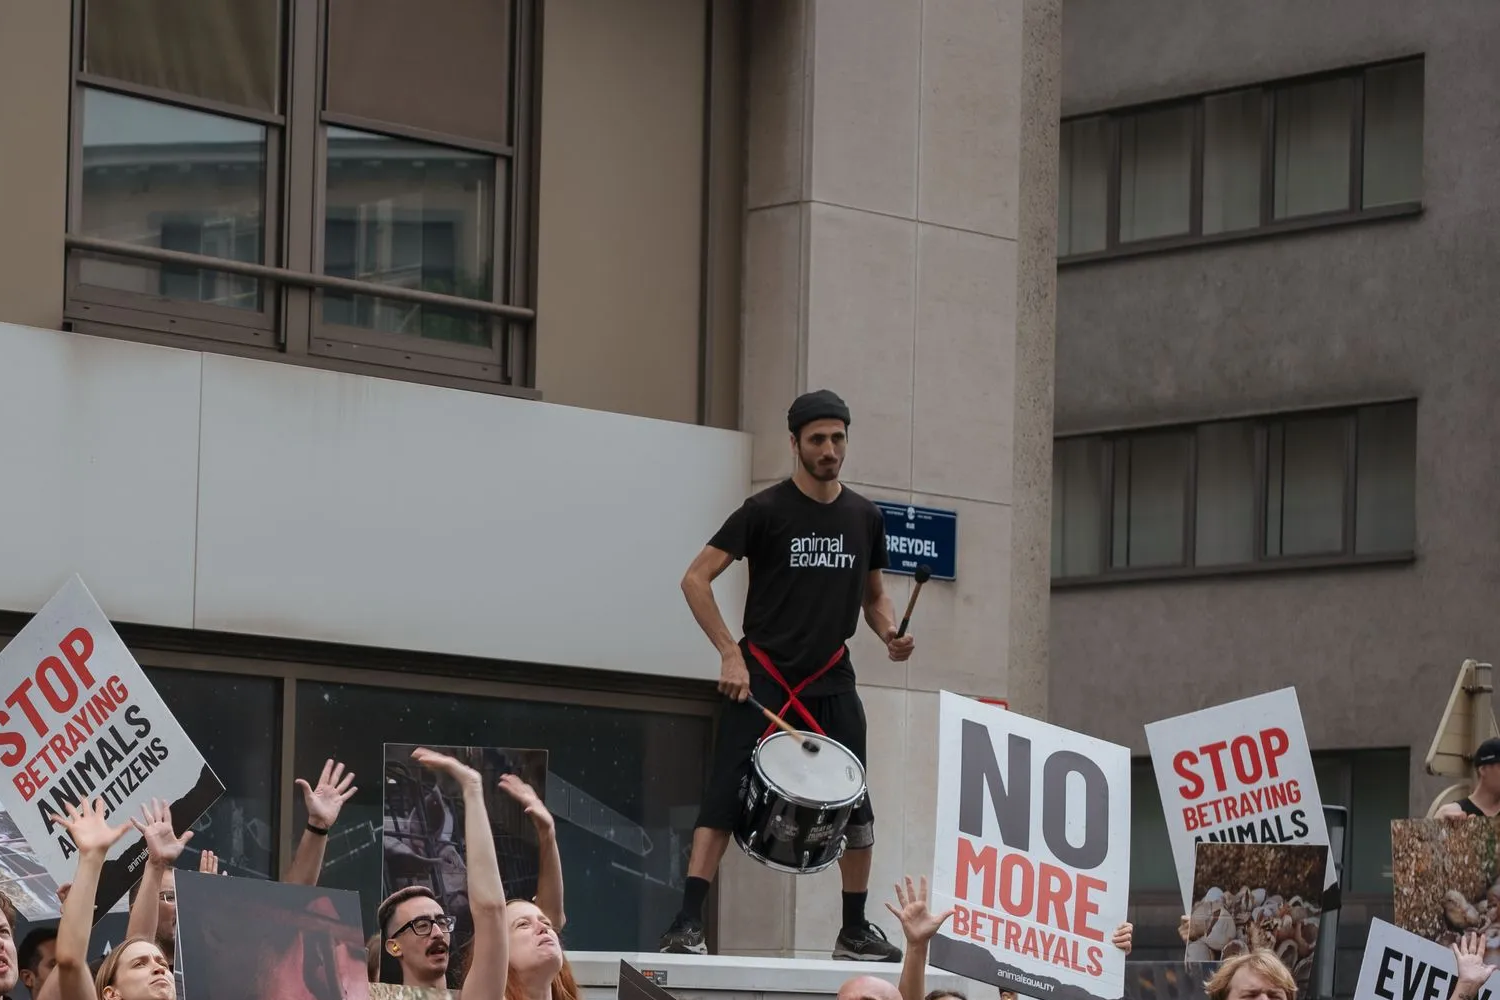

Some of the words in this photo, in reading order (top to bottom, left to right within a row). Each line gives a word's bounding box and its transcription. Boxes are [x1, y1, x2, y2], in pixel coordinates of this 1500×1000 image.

[790, 532, 844, 552] animal
[790, 553, 856, 569] EQUALITY
[12, 675, 129, 801] BETRAYING
[36, 704, 151, 835] ANIMALS
[1173, 727, 1290, 800] STOP
[91, 737, 169, 821] CITIZENS
[961, 718, 1109, 870] NO
[1182, 779, 1302, 832] BETRAYING
[954, 836, 1107, 942] MORE
[952, 904, 1104, 977] BETRAYALS
[997, 968, 1055, 992] animalEQUALITY
